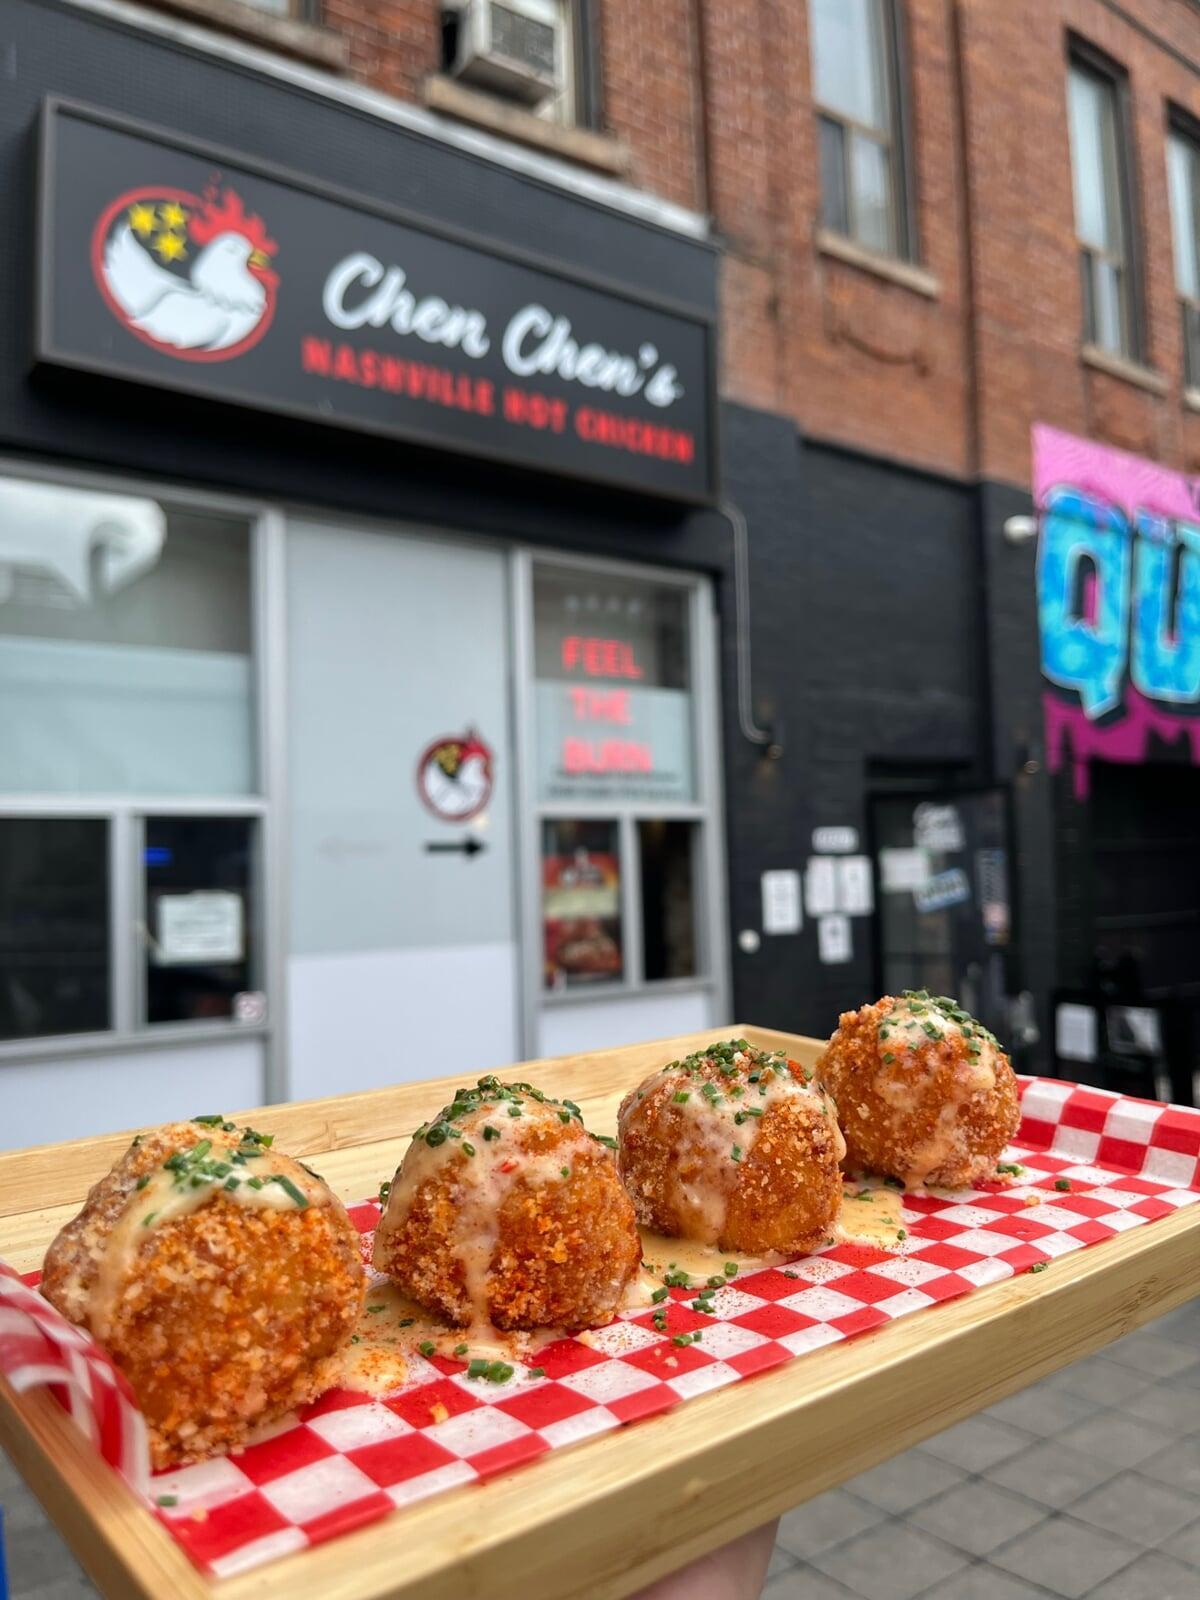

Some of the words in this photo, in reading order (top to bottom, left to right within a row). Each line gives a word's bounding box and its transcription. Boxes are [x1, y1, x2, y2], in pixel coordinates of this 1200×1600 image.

[322, 252, 490, 358] Chen
[502, 303, 684, 408] Chen's
[302, 336, 495, 416] NASHVILLE
[503, 387, 567, 434] HOT
[574, 405, 695, 467] CHICKEN
[562, 635, 643, 680] FEEL
[570, 687, 633, 727] THE
